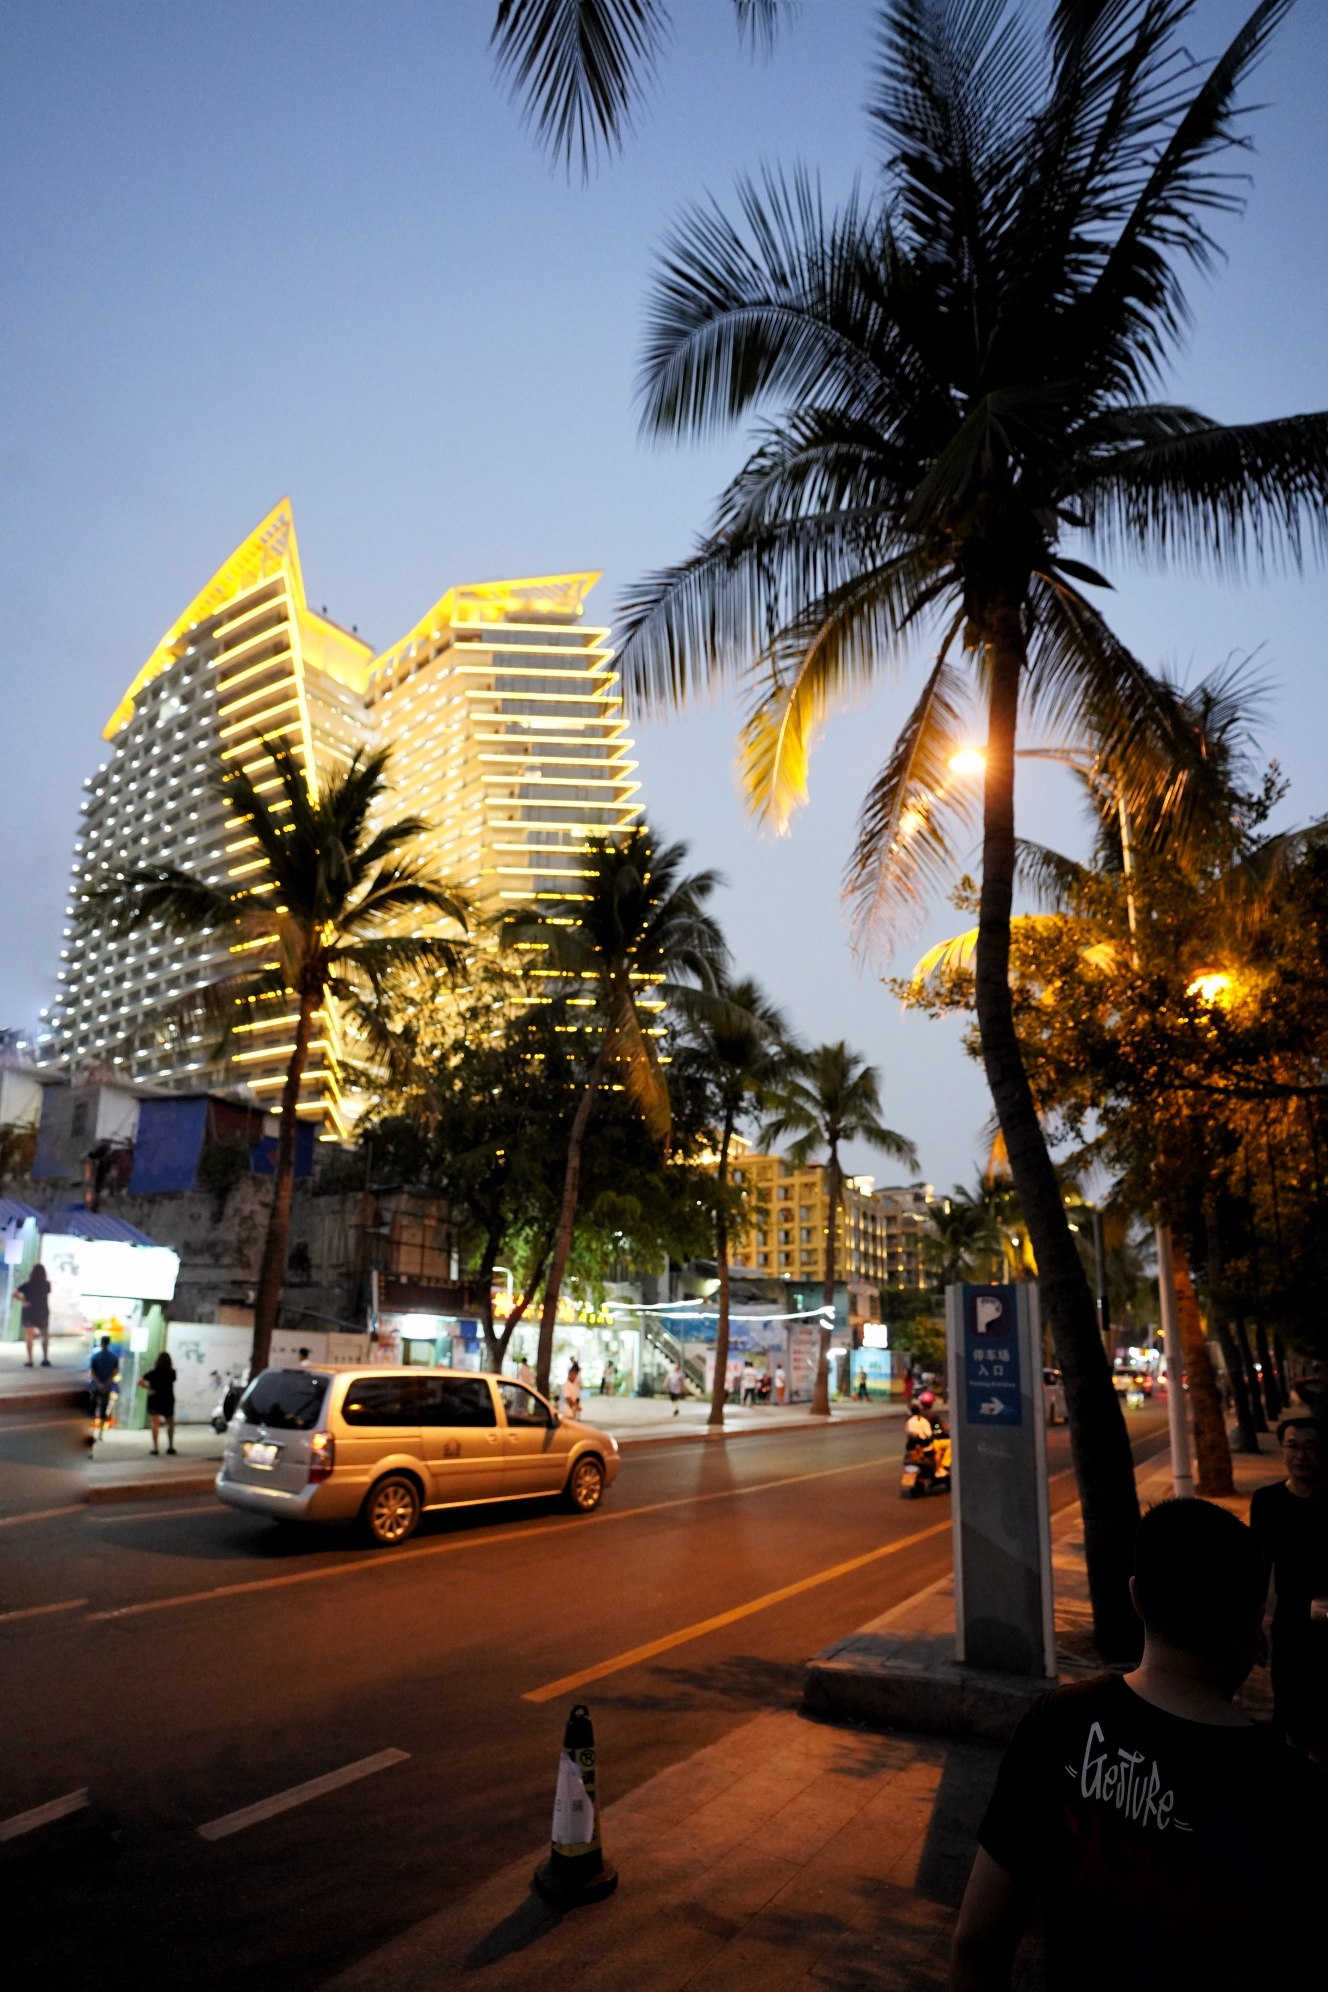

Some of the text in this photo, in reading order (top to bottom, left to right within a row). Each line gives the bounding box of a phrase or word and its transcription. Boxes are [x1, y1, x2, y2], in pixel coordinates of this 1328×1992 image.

[976, 1296, 1003, 1333] P
[973, 1349, 1010, 1363] 停车场
[978, 1365, 1004, 1377] 入口
